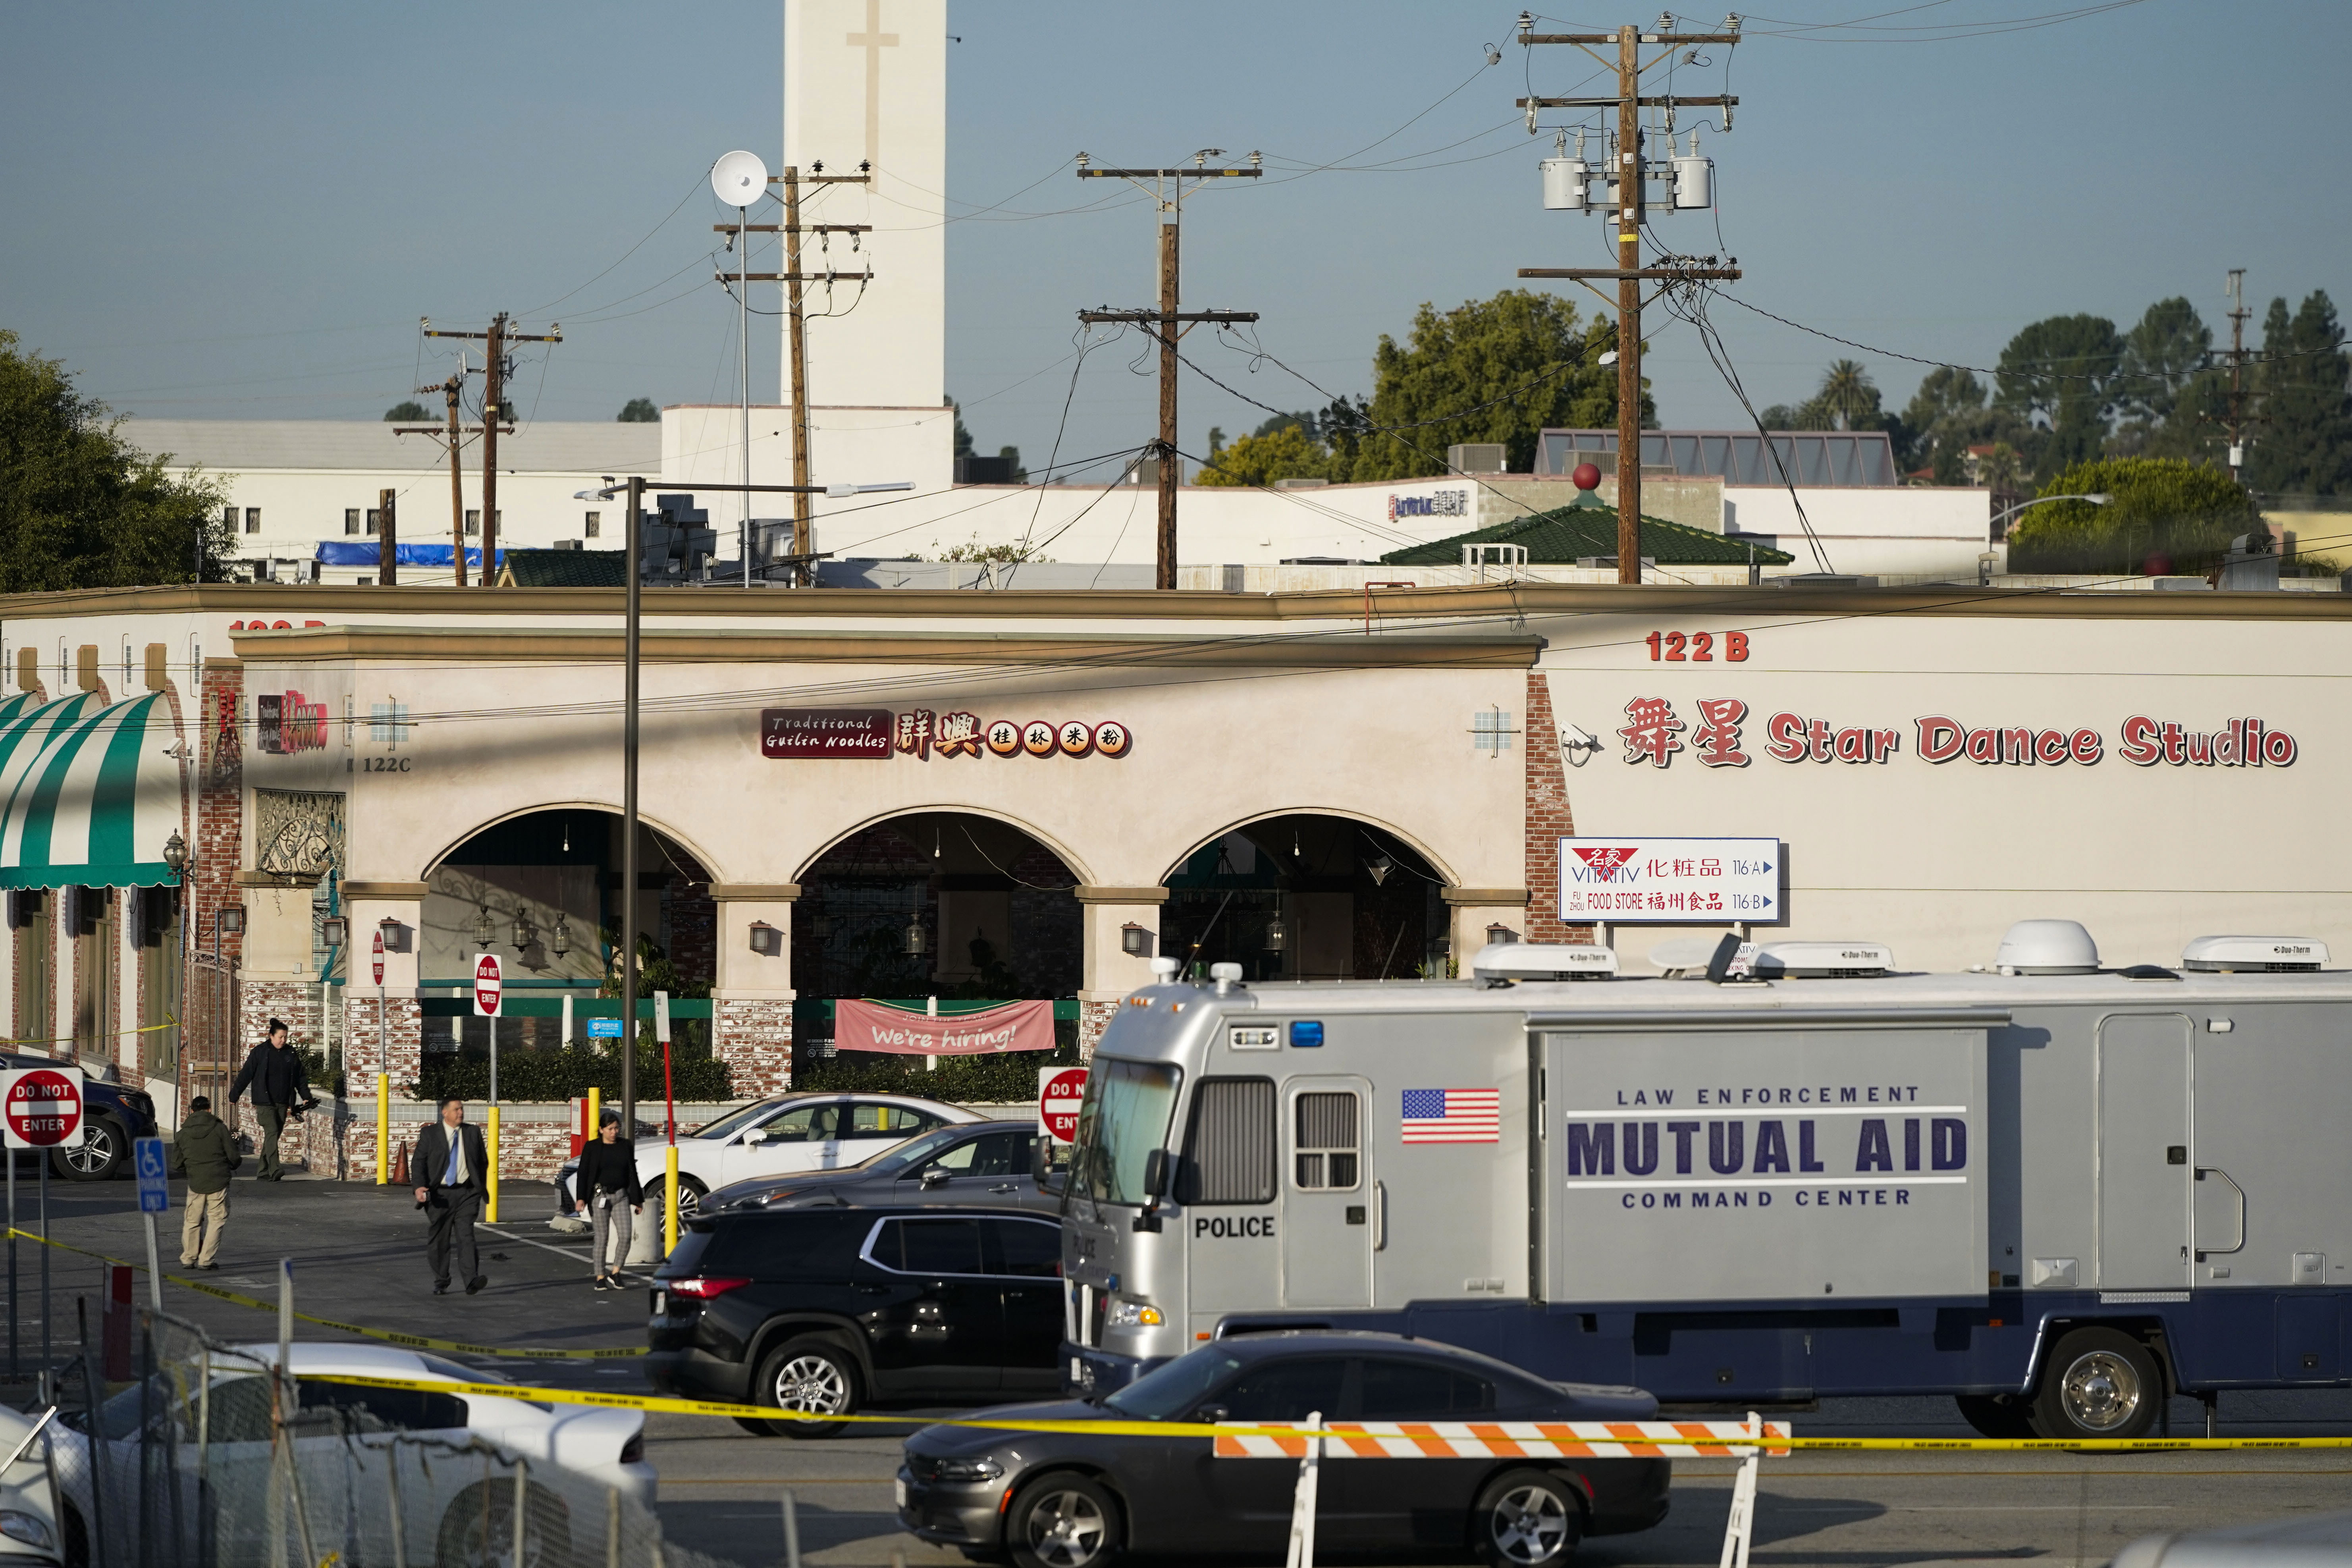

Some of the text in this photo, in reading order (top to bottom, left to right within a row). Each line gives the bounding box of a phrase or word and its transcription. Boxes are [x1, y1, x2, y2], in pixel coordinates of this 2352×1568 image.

[1646, 631, 1749, 662] 122 B
[773, 715, 873, 730] Traditional
[993, 727, 1120, 746] 桂林米粉
[1617, 696, 1749, 767] 舞星
[1766, 711, 2296, 766] Star Dance Studio
[766, 733, 887, 748] Guilin Noodles
[364, 758, 410, 772] 122C
[1586, 849, 1624, 866] 名家
[1571, 867, 1640, 883] VITATIV
[1646, 858, 1722, 877] 化粧品
[1733, 860, 1761, 875] 116-A
[1573, 891, 1581, 900] FU
[1588, 893, 1643, 910] FOOD STORE
[1647, 891, 1723, 911] 福州食品
[1733, 894, 1760, 909] 116-B
[1570, 903, 1584, 911] ZHOU
[479, 966, 498, 977] DO NOT
[481, 993, 496, 1004] ENTER
[871, 1025, 1016, 1050] We're hiring!
[16, 1084, 70, 1098] DO NOT
[1051, 1083, 1070, 1096] DO
[1617, 1085, 1919, 1105] LAW ENFORCEMENT
[22, 1119, 65, 1132] ENTER
[1567, 1118, 1967, 1176] MUTUAL AID
[1621, 1188, 1911, 1208] COMMAND CENTER
[1195, 1216, 1275, 1239] POLICE
